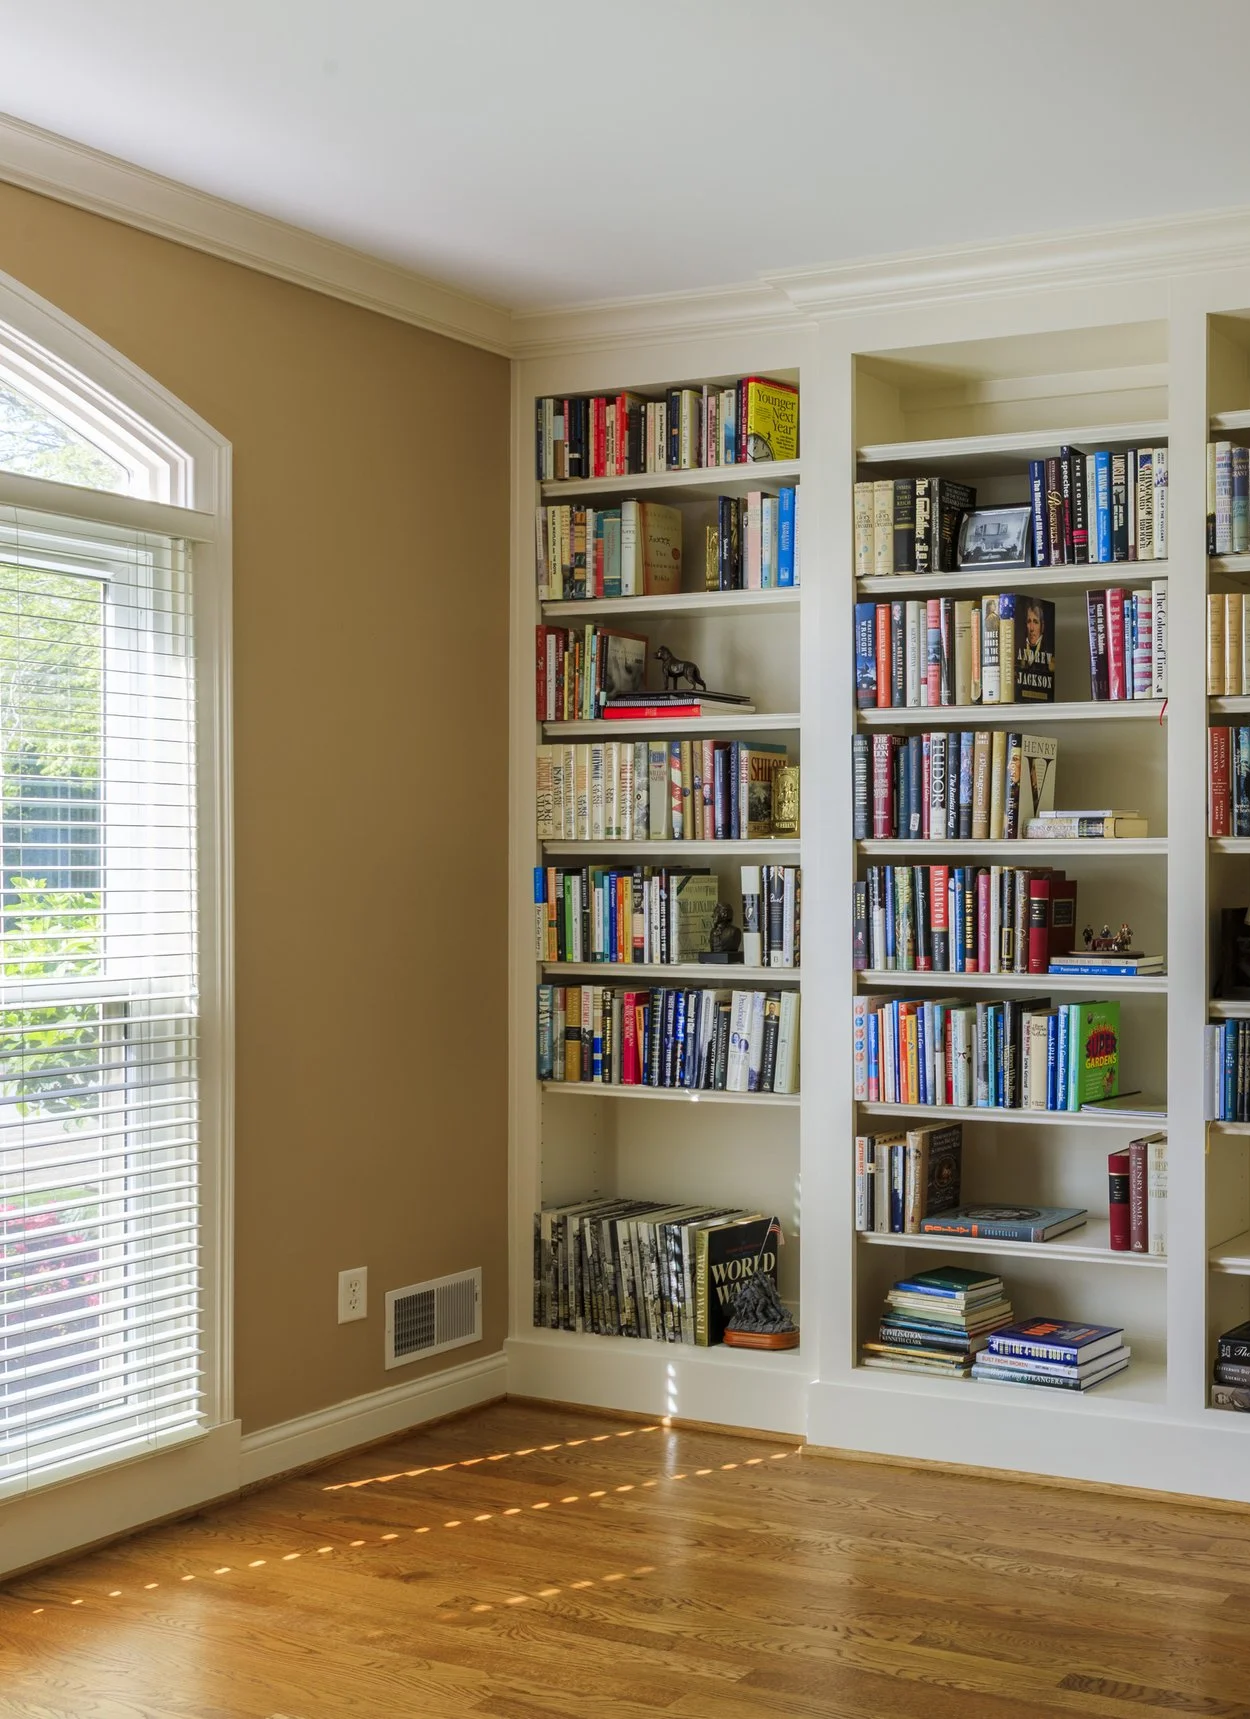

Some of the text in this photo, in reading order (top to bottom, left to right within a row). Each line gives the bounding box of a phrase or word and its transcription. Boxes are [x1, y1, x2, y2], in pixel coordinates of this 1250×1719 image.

[756, 389, 795, 411] Younger
[772, 408, 794, 424] Next
[916, 480, 930, 539] The Godfather
[1157, 592, 1166, 680] The Colour of Time
[1024, 740, 1056, 756] HENRY
[855, 758, 867, 806] CHURCHILL
[932, 742, 944, 805] TUDOR
[977, 759, 986, 805] Plantagenets
[1024, 756, 1055, 817] V
[935, 870, 944, 924] WASHINGTON
[540, 990, 550, 1026] D-DAY
[712, 1252, 776, 1284] WORLD
